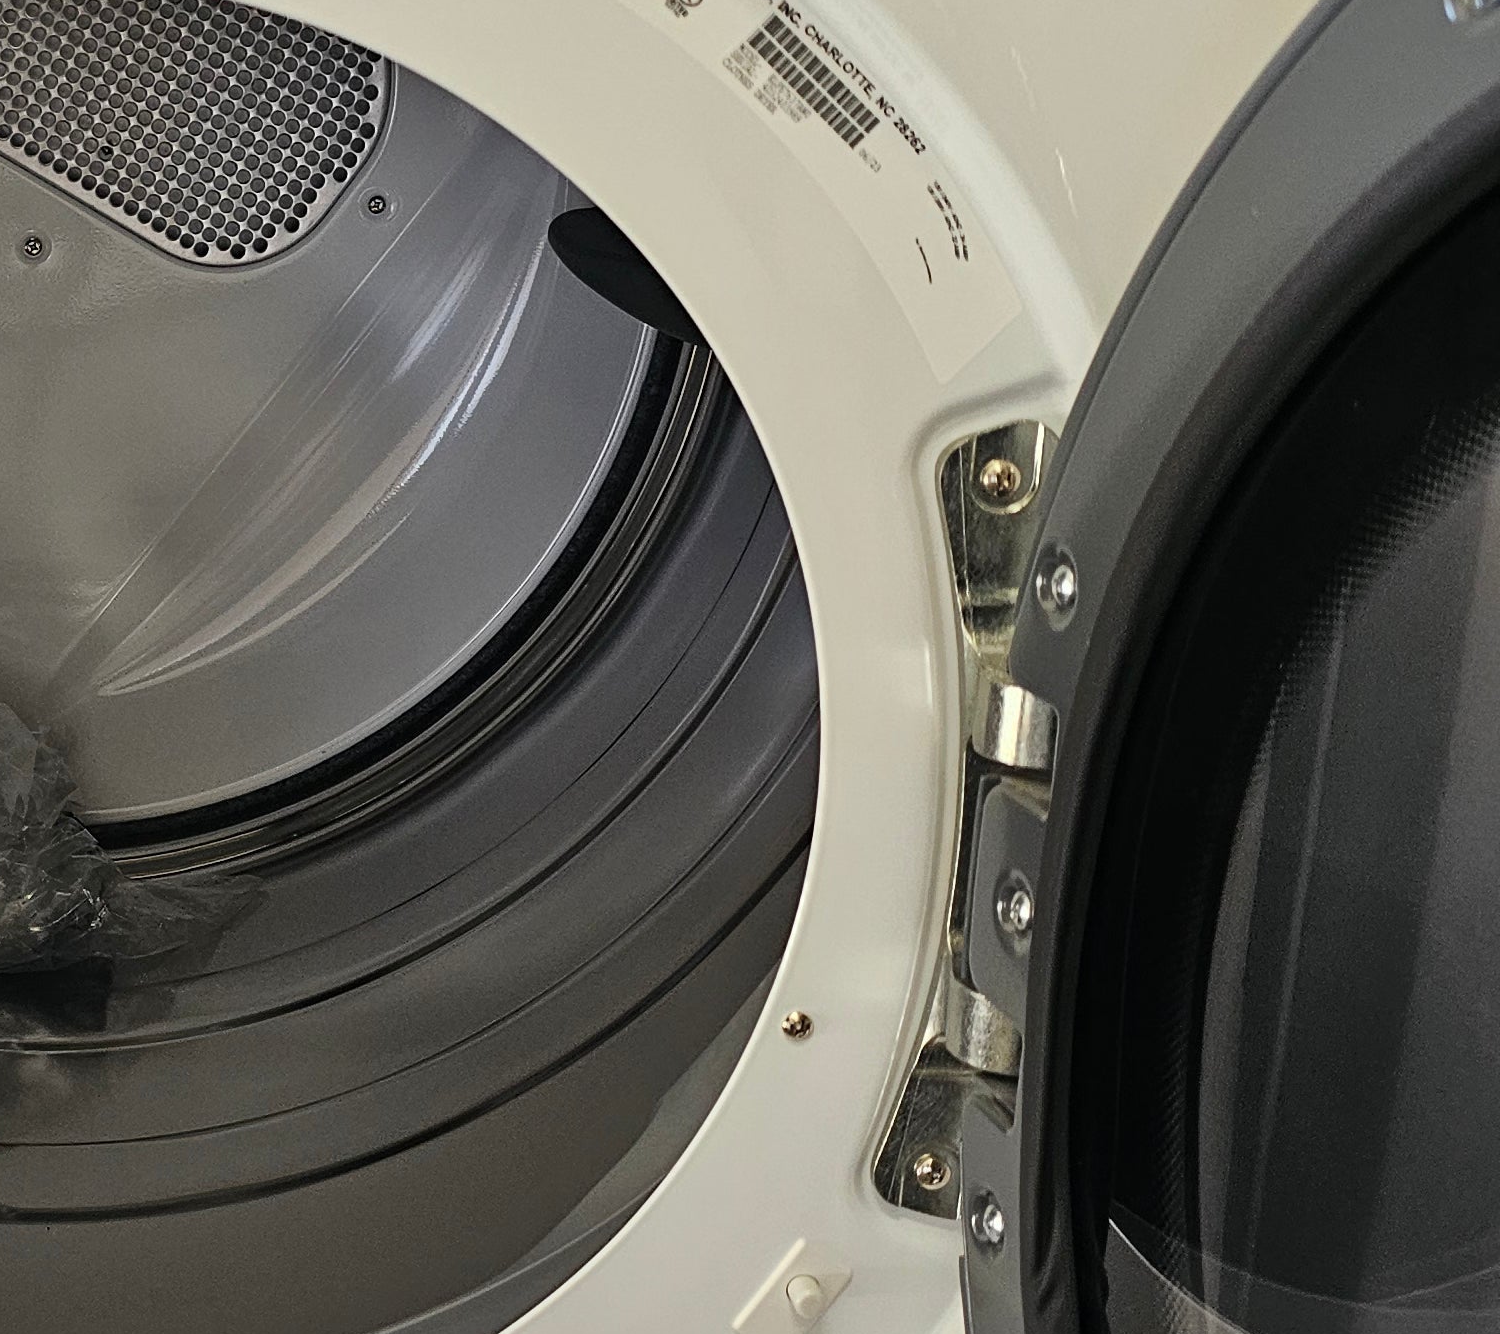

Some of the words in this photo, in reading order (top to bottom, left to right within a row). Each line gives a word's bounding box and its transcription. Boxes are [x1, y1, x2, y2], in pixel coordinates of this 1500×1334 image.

[803, 23, 878, 100] CHARLOTTE,
[874, 94, 897, 121] NC
[892, 113, 929, 156] 28262
